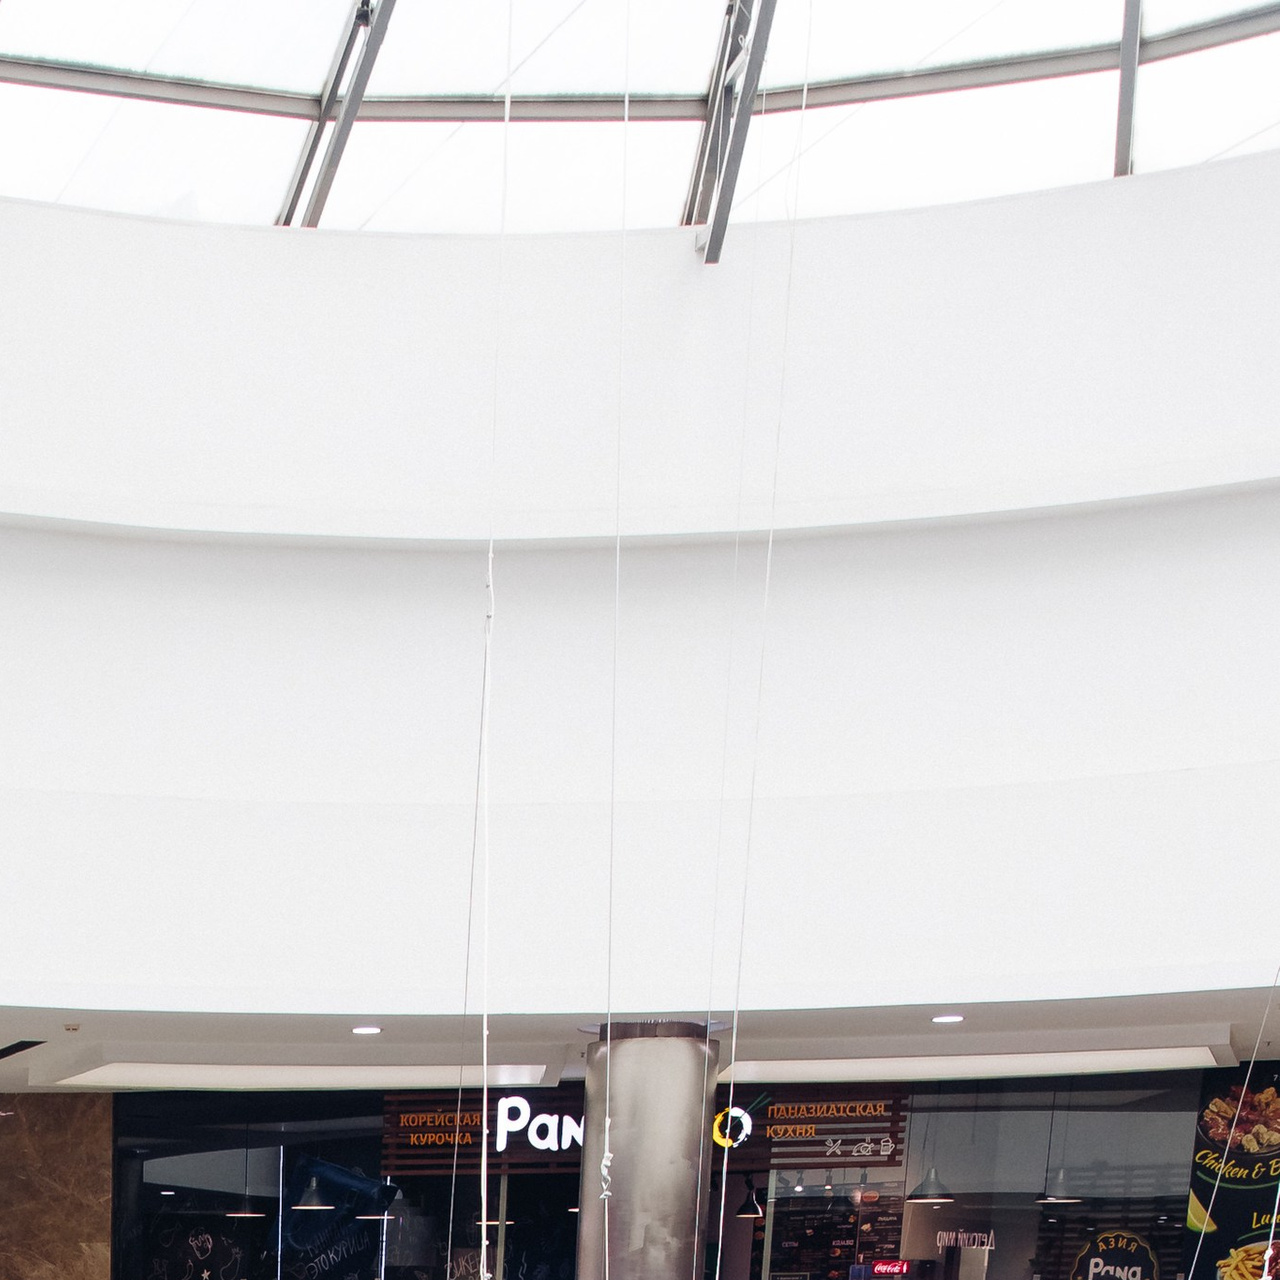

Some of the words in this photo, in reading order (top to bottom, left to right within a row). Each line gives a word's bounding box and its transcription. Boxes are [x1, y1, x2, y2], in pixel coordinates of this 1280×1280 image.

[400, 1109, 481, 1127] КОРЕЙСКАЯ
[768, 1103, 886, 1119] ПАНАЗИАТСКАЯ
[766, 1124, 816, 1138] КУХНЯ
[410, 1133, 472, 1146] КУРОЧКА
[1195, 1149, 1248, 1179] Chicken
[1099, 1238, 1137, 1253] АЗИЯ
